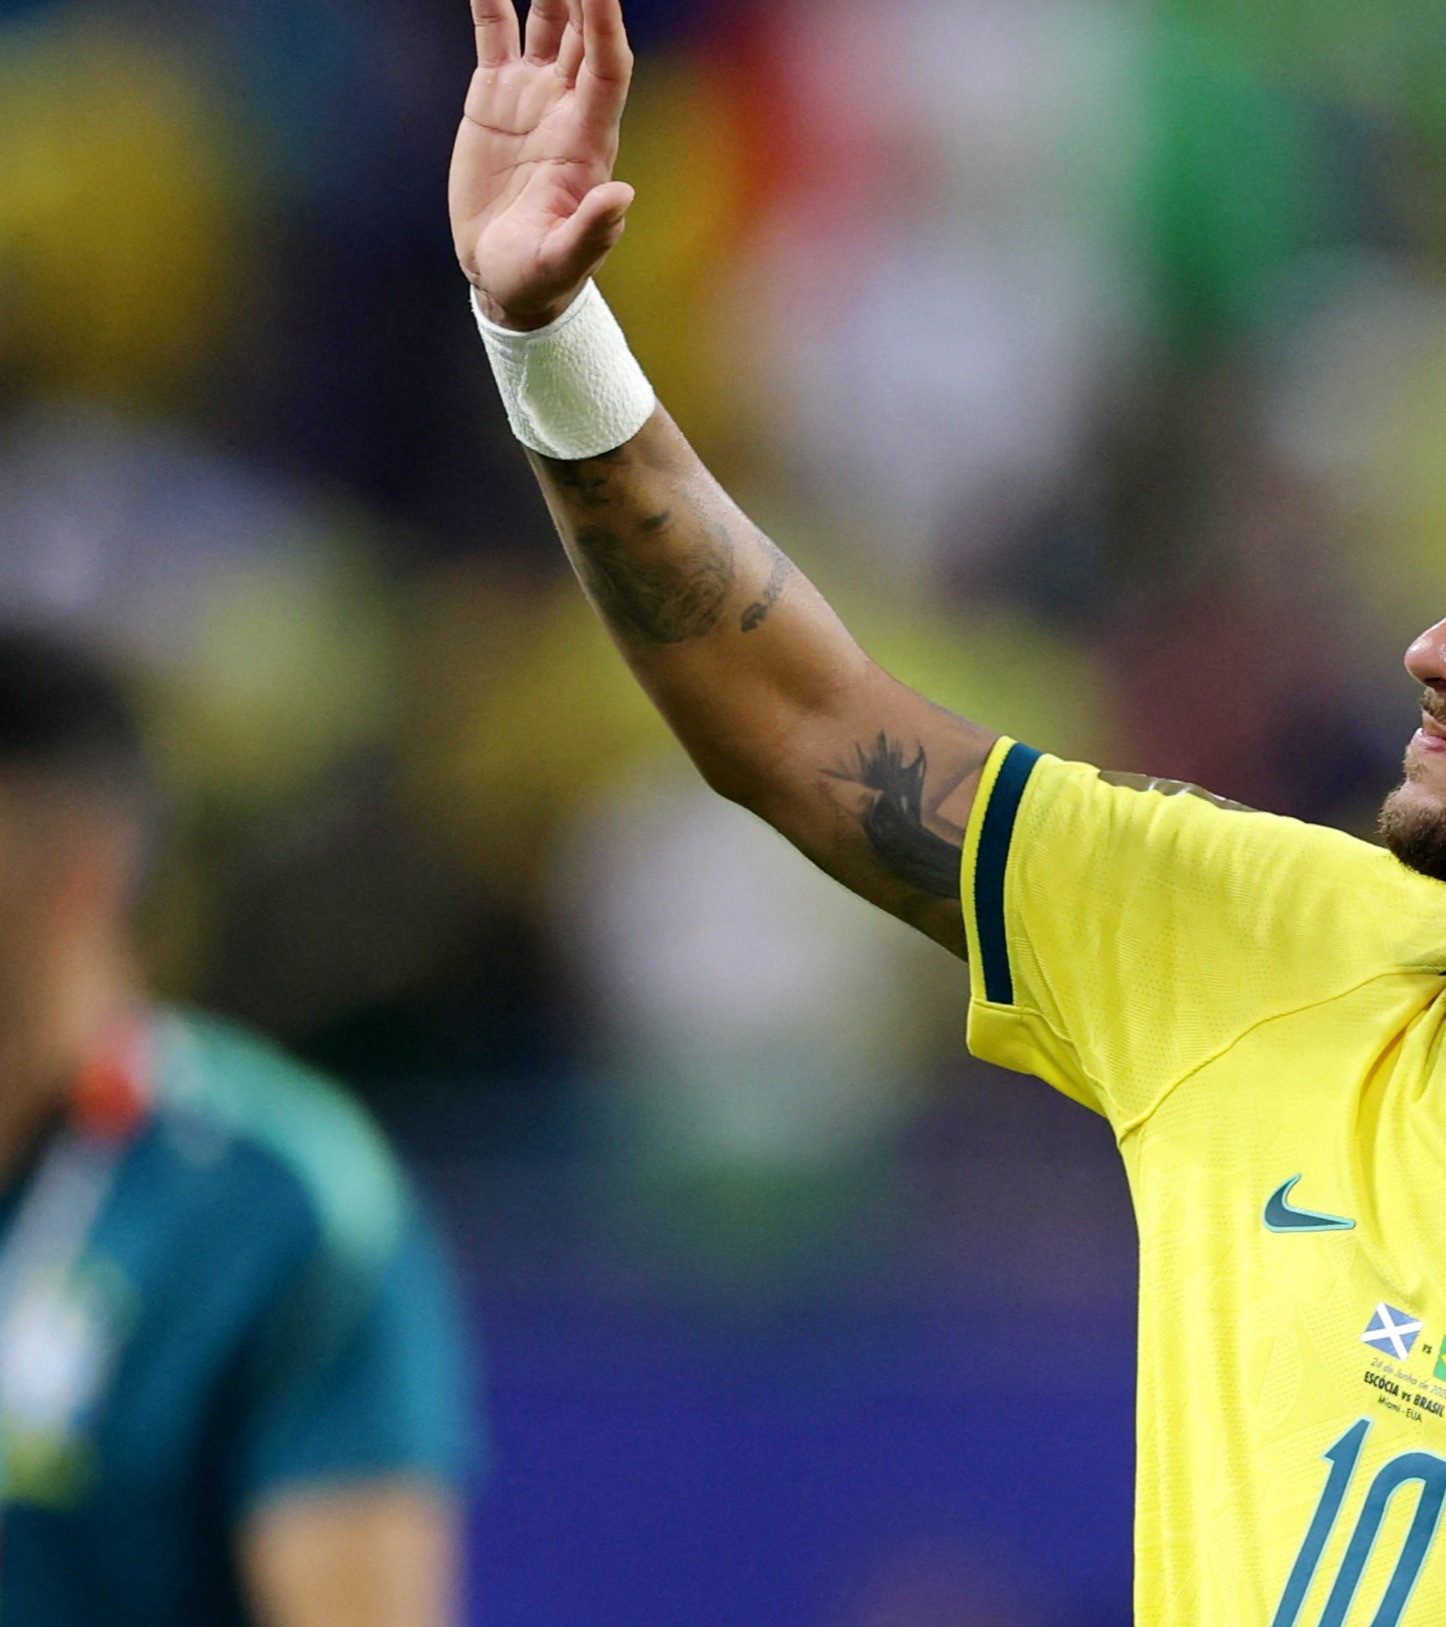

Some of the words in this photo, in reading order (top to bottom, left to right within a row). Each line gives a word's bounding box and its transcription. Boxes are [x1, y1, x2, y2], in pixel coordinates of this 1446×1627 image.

[1364, 1371, 1399, 1396] ESCÓCIA
[1401, 1391, 1412, 1402] vs
[1413, 1394, 1445, 1417] BRASIL
[1378, 1395, 1400, 1413] Miami
[1406, 1408, 1422, 1422] EUA
